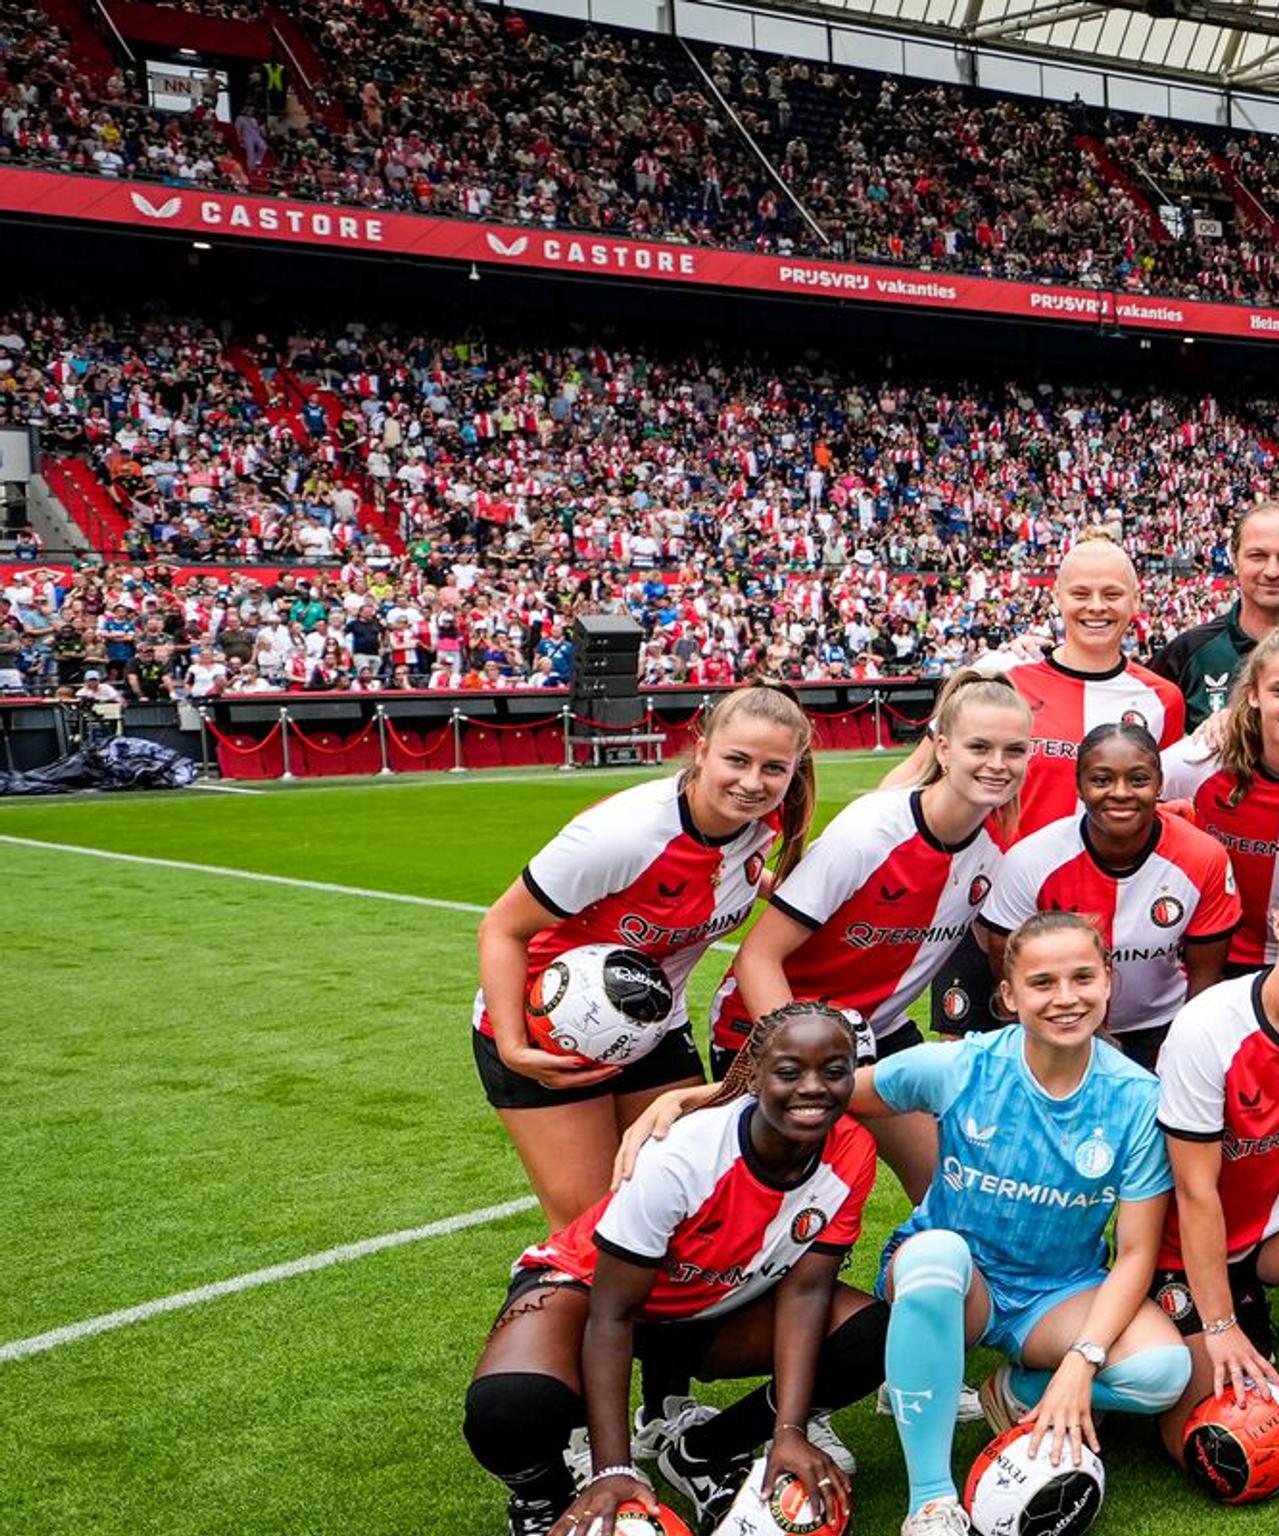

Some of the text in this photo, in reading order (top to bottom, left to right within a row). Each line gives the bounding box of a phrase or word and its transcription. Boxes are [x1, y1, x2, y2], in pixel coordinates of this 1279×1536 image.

[201, 201, 383, 242] CASTORE
[543, 239, 695, 274] CASTORE
[876, 279, 957, 299] vakanties
[1115, 303, 1183, 322] vakanties
